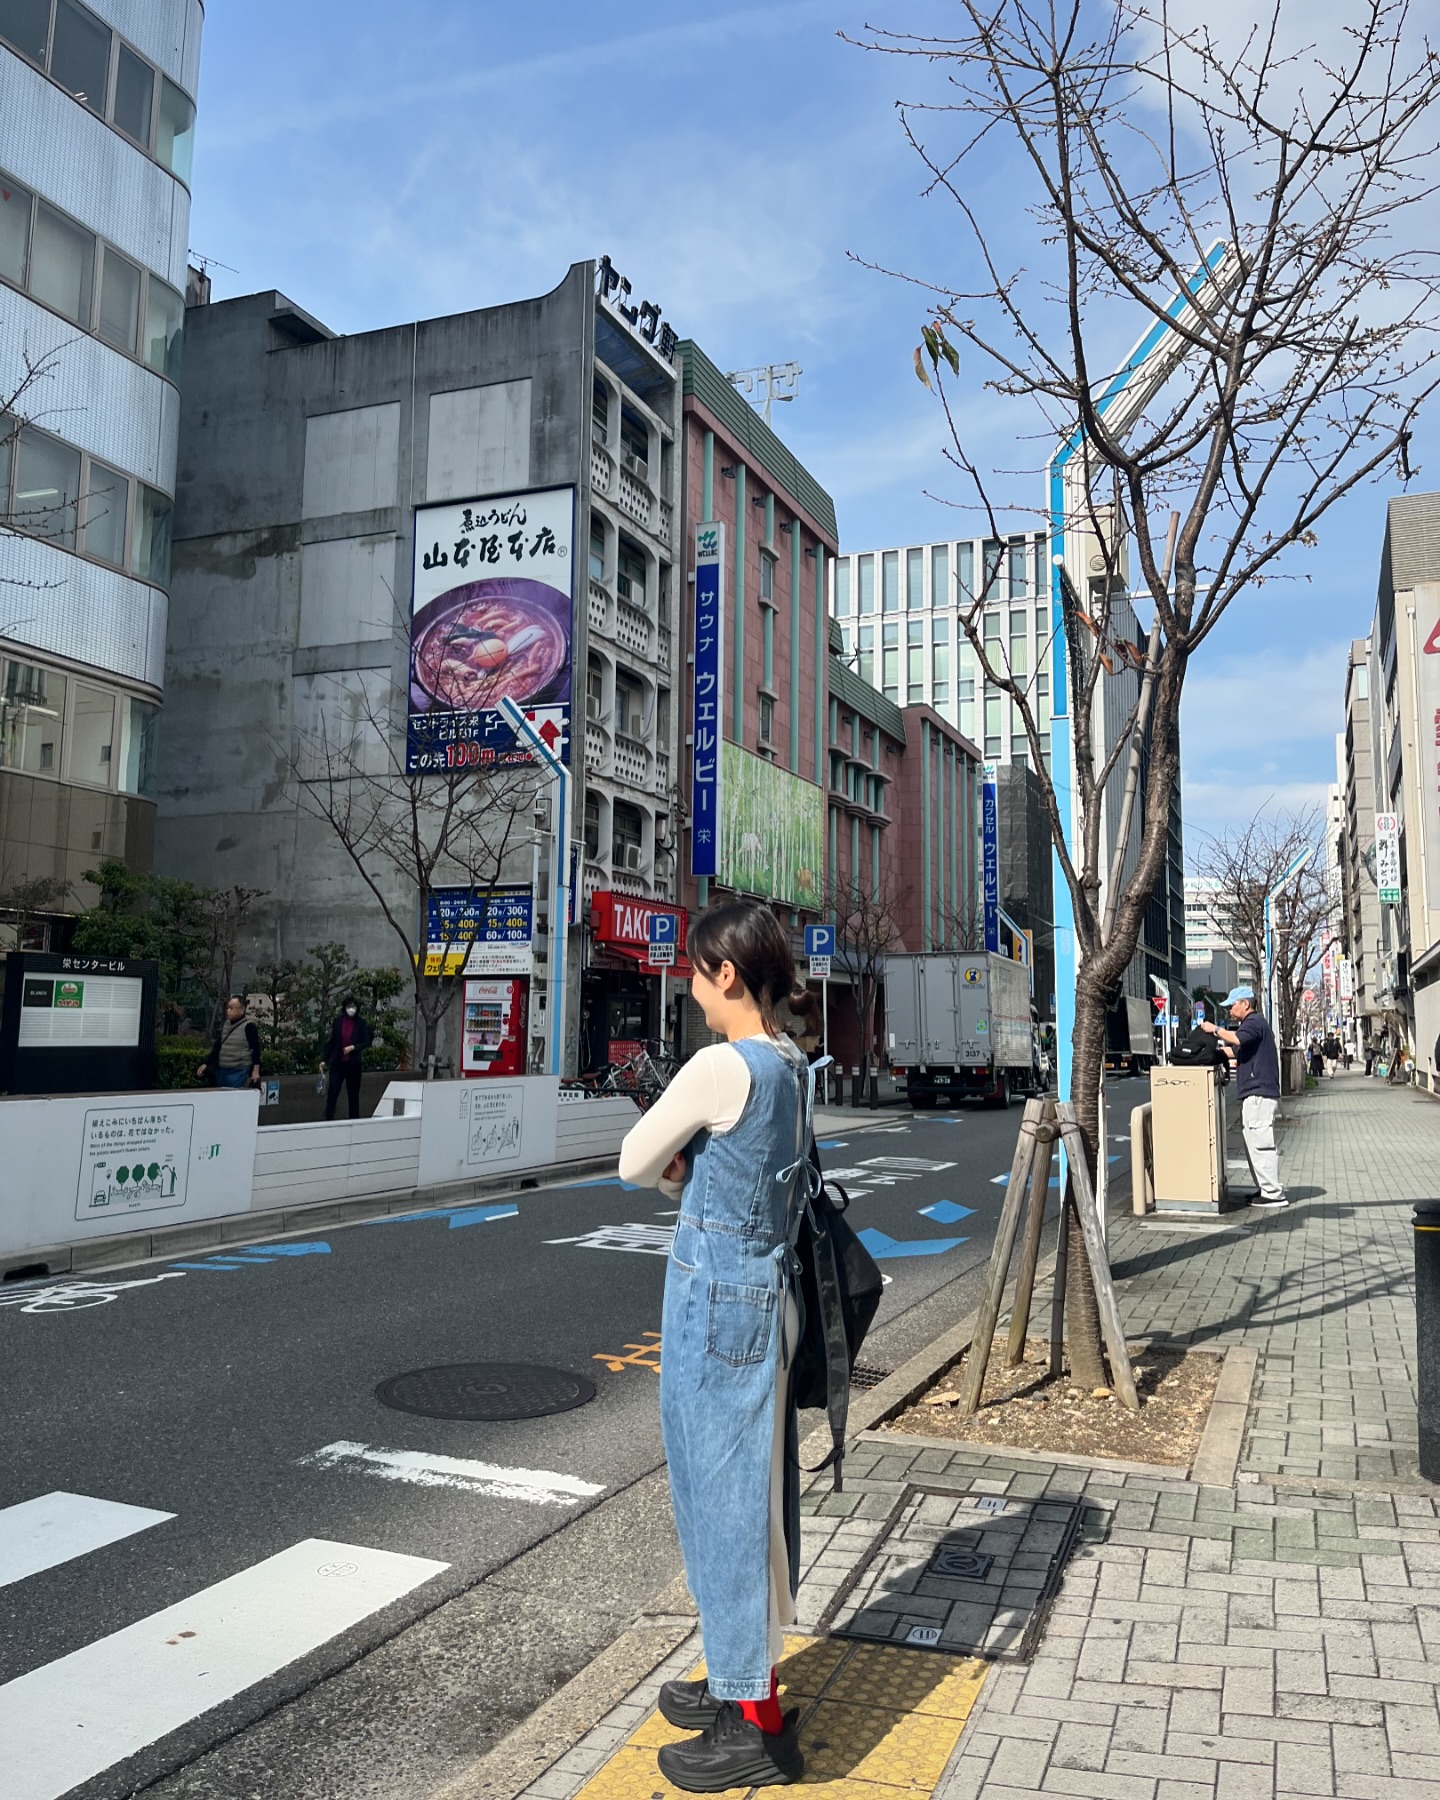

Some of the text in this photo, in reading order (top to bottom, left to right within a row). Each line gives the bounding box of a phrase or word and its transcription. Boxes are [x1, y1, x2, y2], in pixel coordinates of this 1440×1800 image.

[423, 526, 556, 570] 山本屋本店
[700, 591, 715, 652] サウナ
[697, 828, 711, 844] 栄
[655, 917, 670, 940] P
[812, 928, 830, 952] P
[62, 958, 125, 971] 栄センタービル
[208, 1144, 221, 1159] JT
